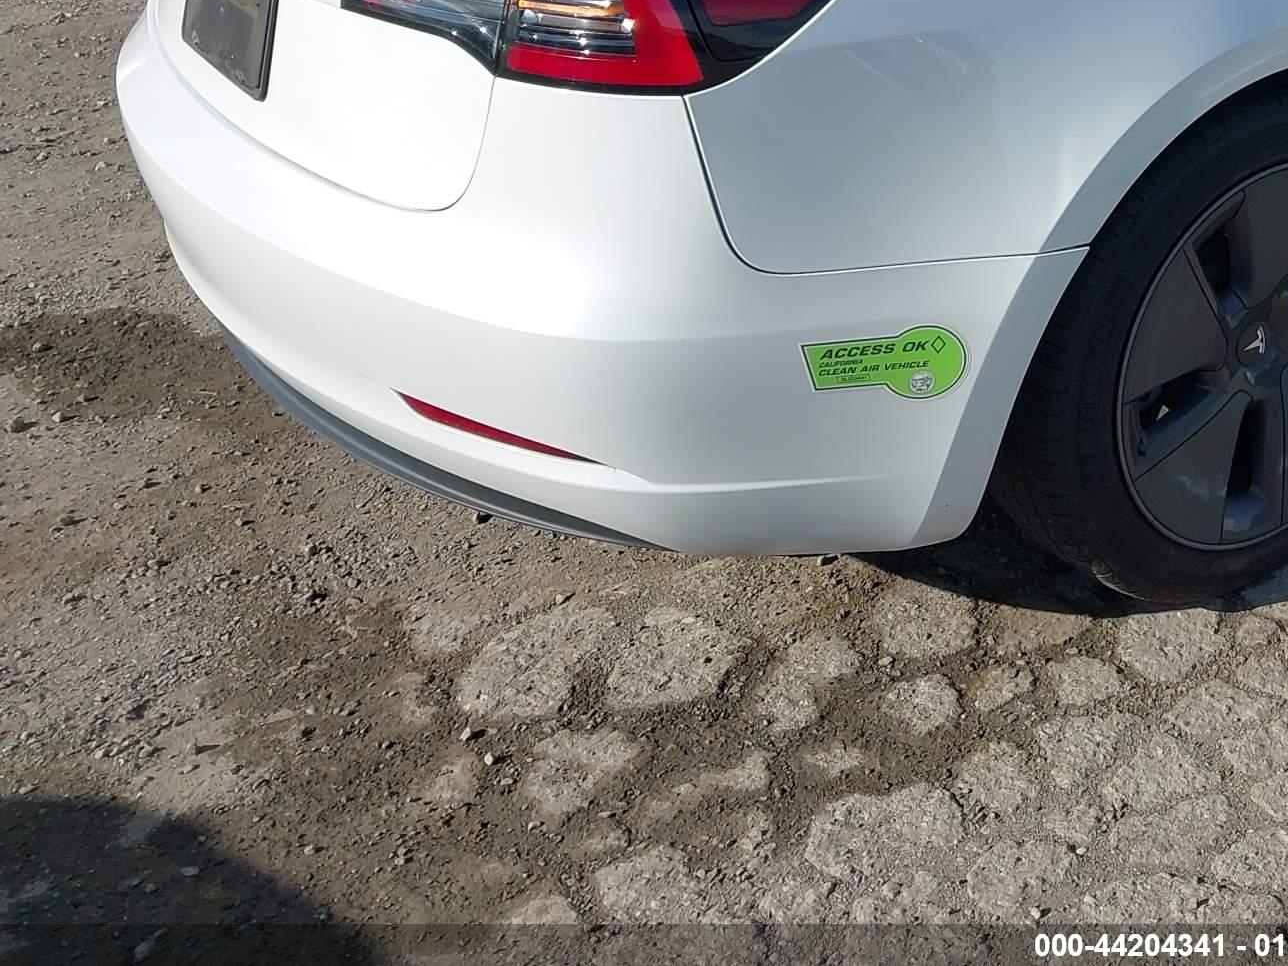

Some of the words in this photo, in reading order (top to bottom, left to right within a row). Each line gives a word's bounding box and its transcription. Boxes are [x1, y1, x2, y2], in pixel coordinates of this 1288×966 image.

[820, 343, 896, 360] ACCESS
[902, 340, 930, 353] OK
[818, 367, 857, 376] CLEAN
[860, 365, 880, 373] AIR
[884, 360, 930, 371] VEHICLE
[819, 359, 863, 368] CALIFORNIA
